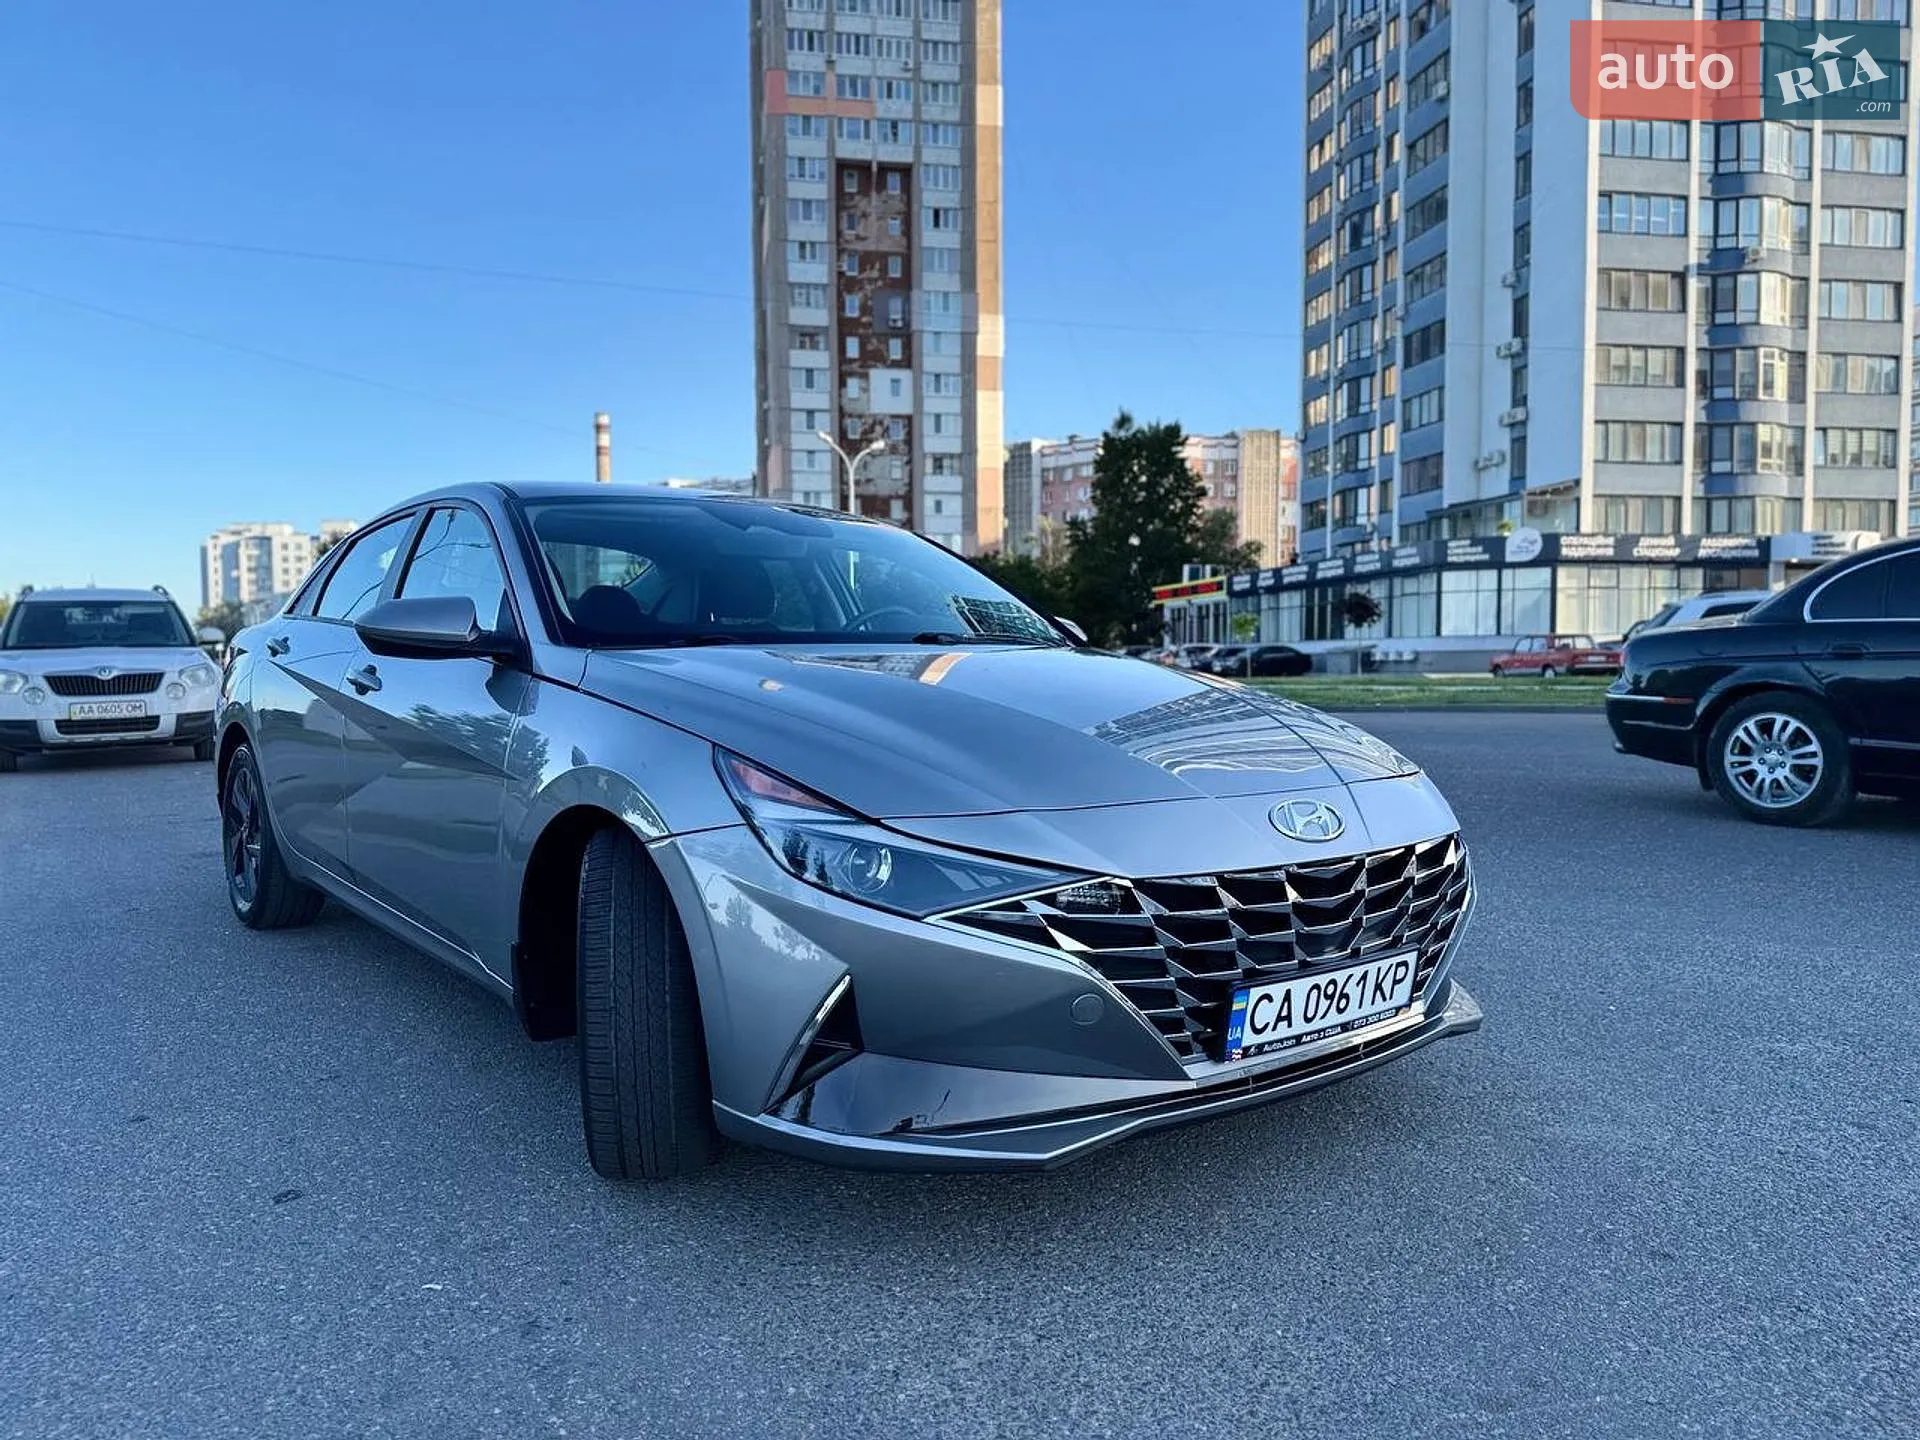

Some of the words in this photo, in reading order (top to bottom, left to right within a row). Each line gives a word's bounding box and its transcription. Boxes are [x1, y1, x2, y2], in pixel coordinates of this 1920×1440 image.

[79, 705, 95, 715] AA
[97, 703, 123, 714] 0605
[126, 702, 144, 713] OM
[1250, 988, 1293, 1036] CA
[1303, 969, 1369, 1024] 0961
[1370, 959, 1410, 1006] KP
[1227, 1026, 1242, 1041] UA
